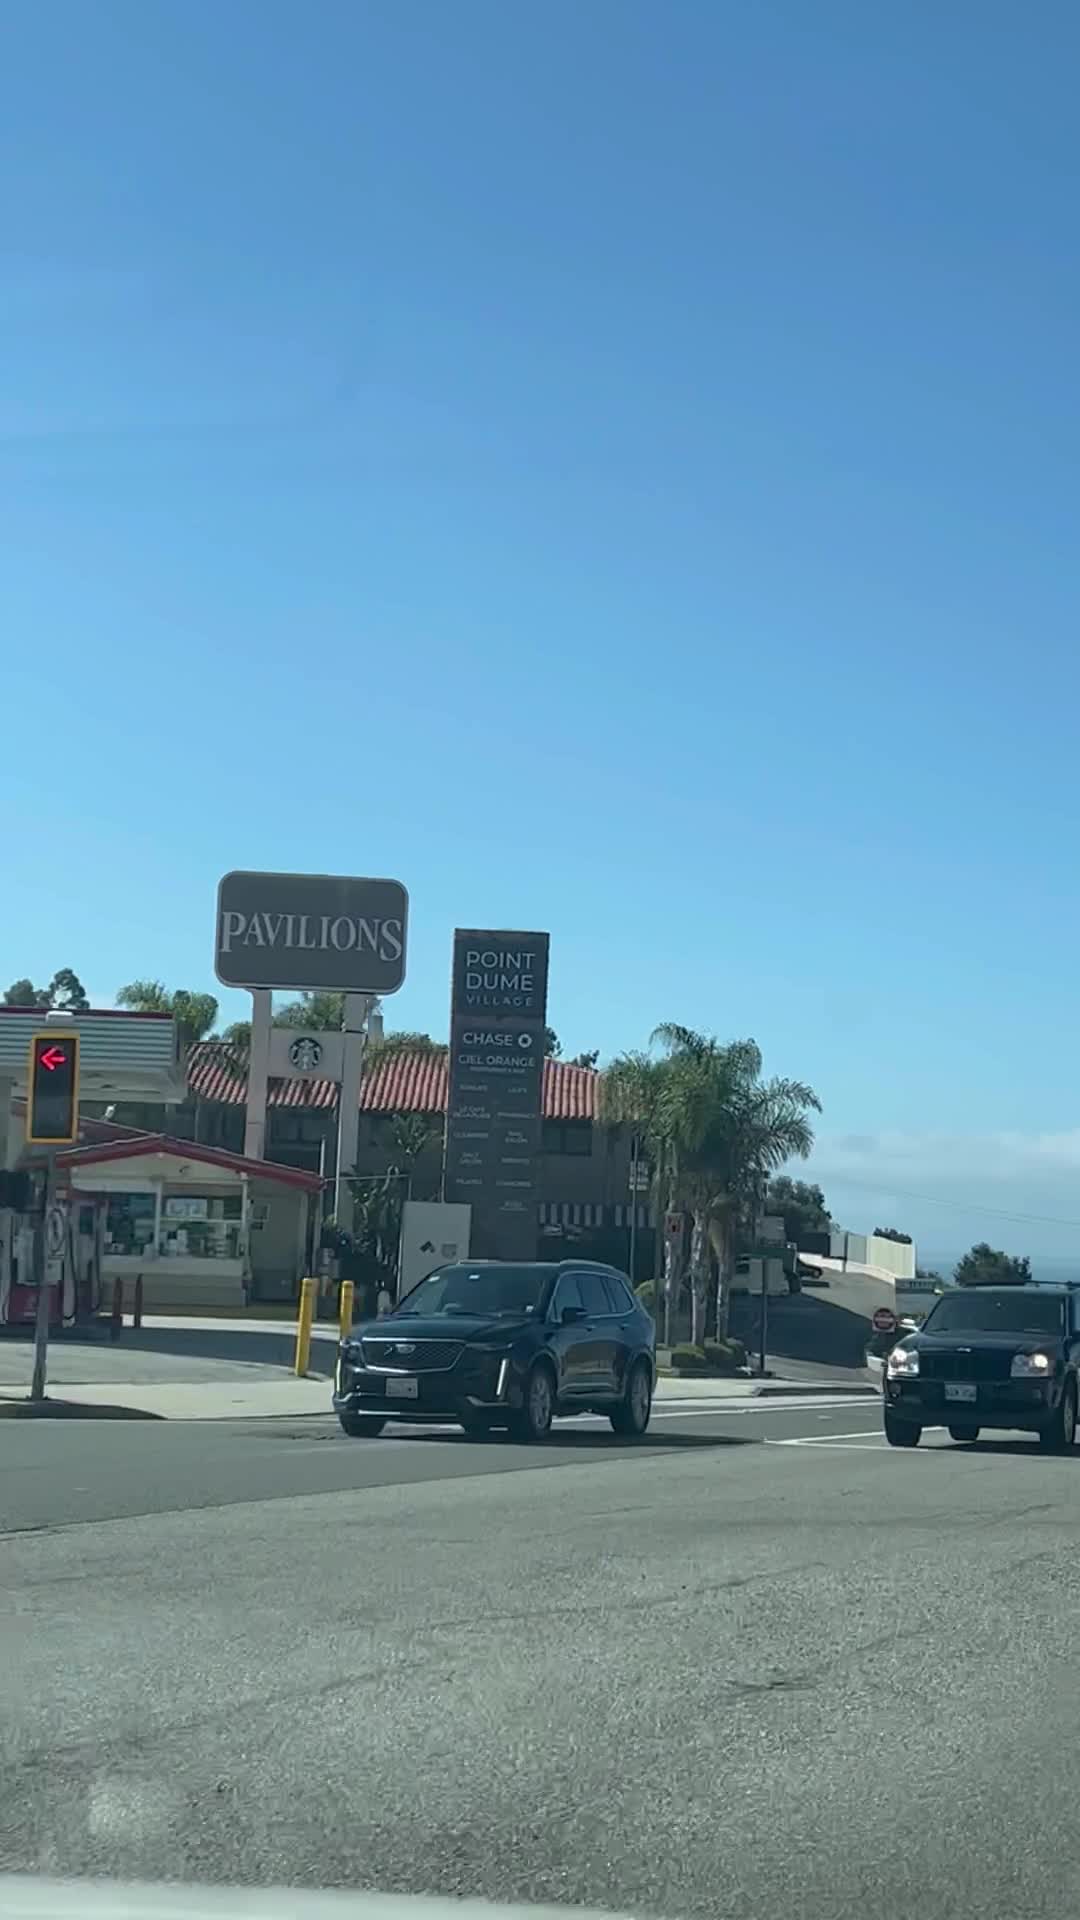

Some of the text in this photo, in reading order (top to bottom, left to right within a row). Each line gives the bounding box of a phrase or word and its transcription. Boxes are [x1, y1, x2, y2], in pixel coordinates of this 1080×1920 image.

[220, 911, 402, 961] PAVILIONS
[466, 951, 536, 969] POINT
[466, 972, 534, 991] DUME
[466, 994, 533, 1007] VILLAGE
[463, 1032, 513, 1047] CHASE
[458, 1055, 536, 1068] CIEL ORANGE
